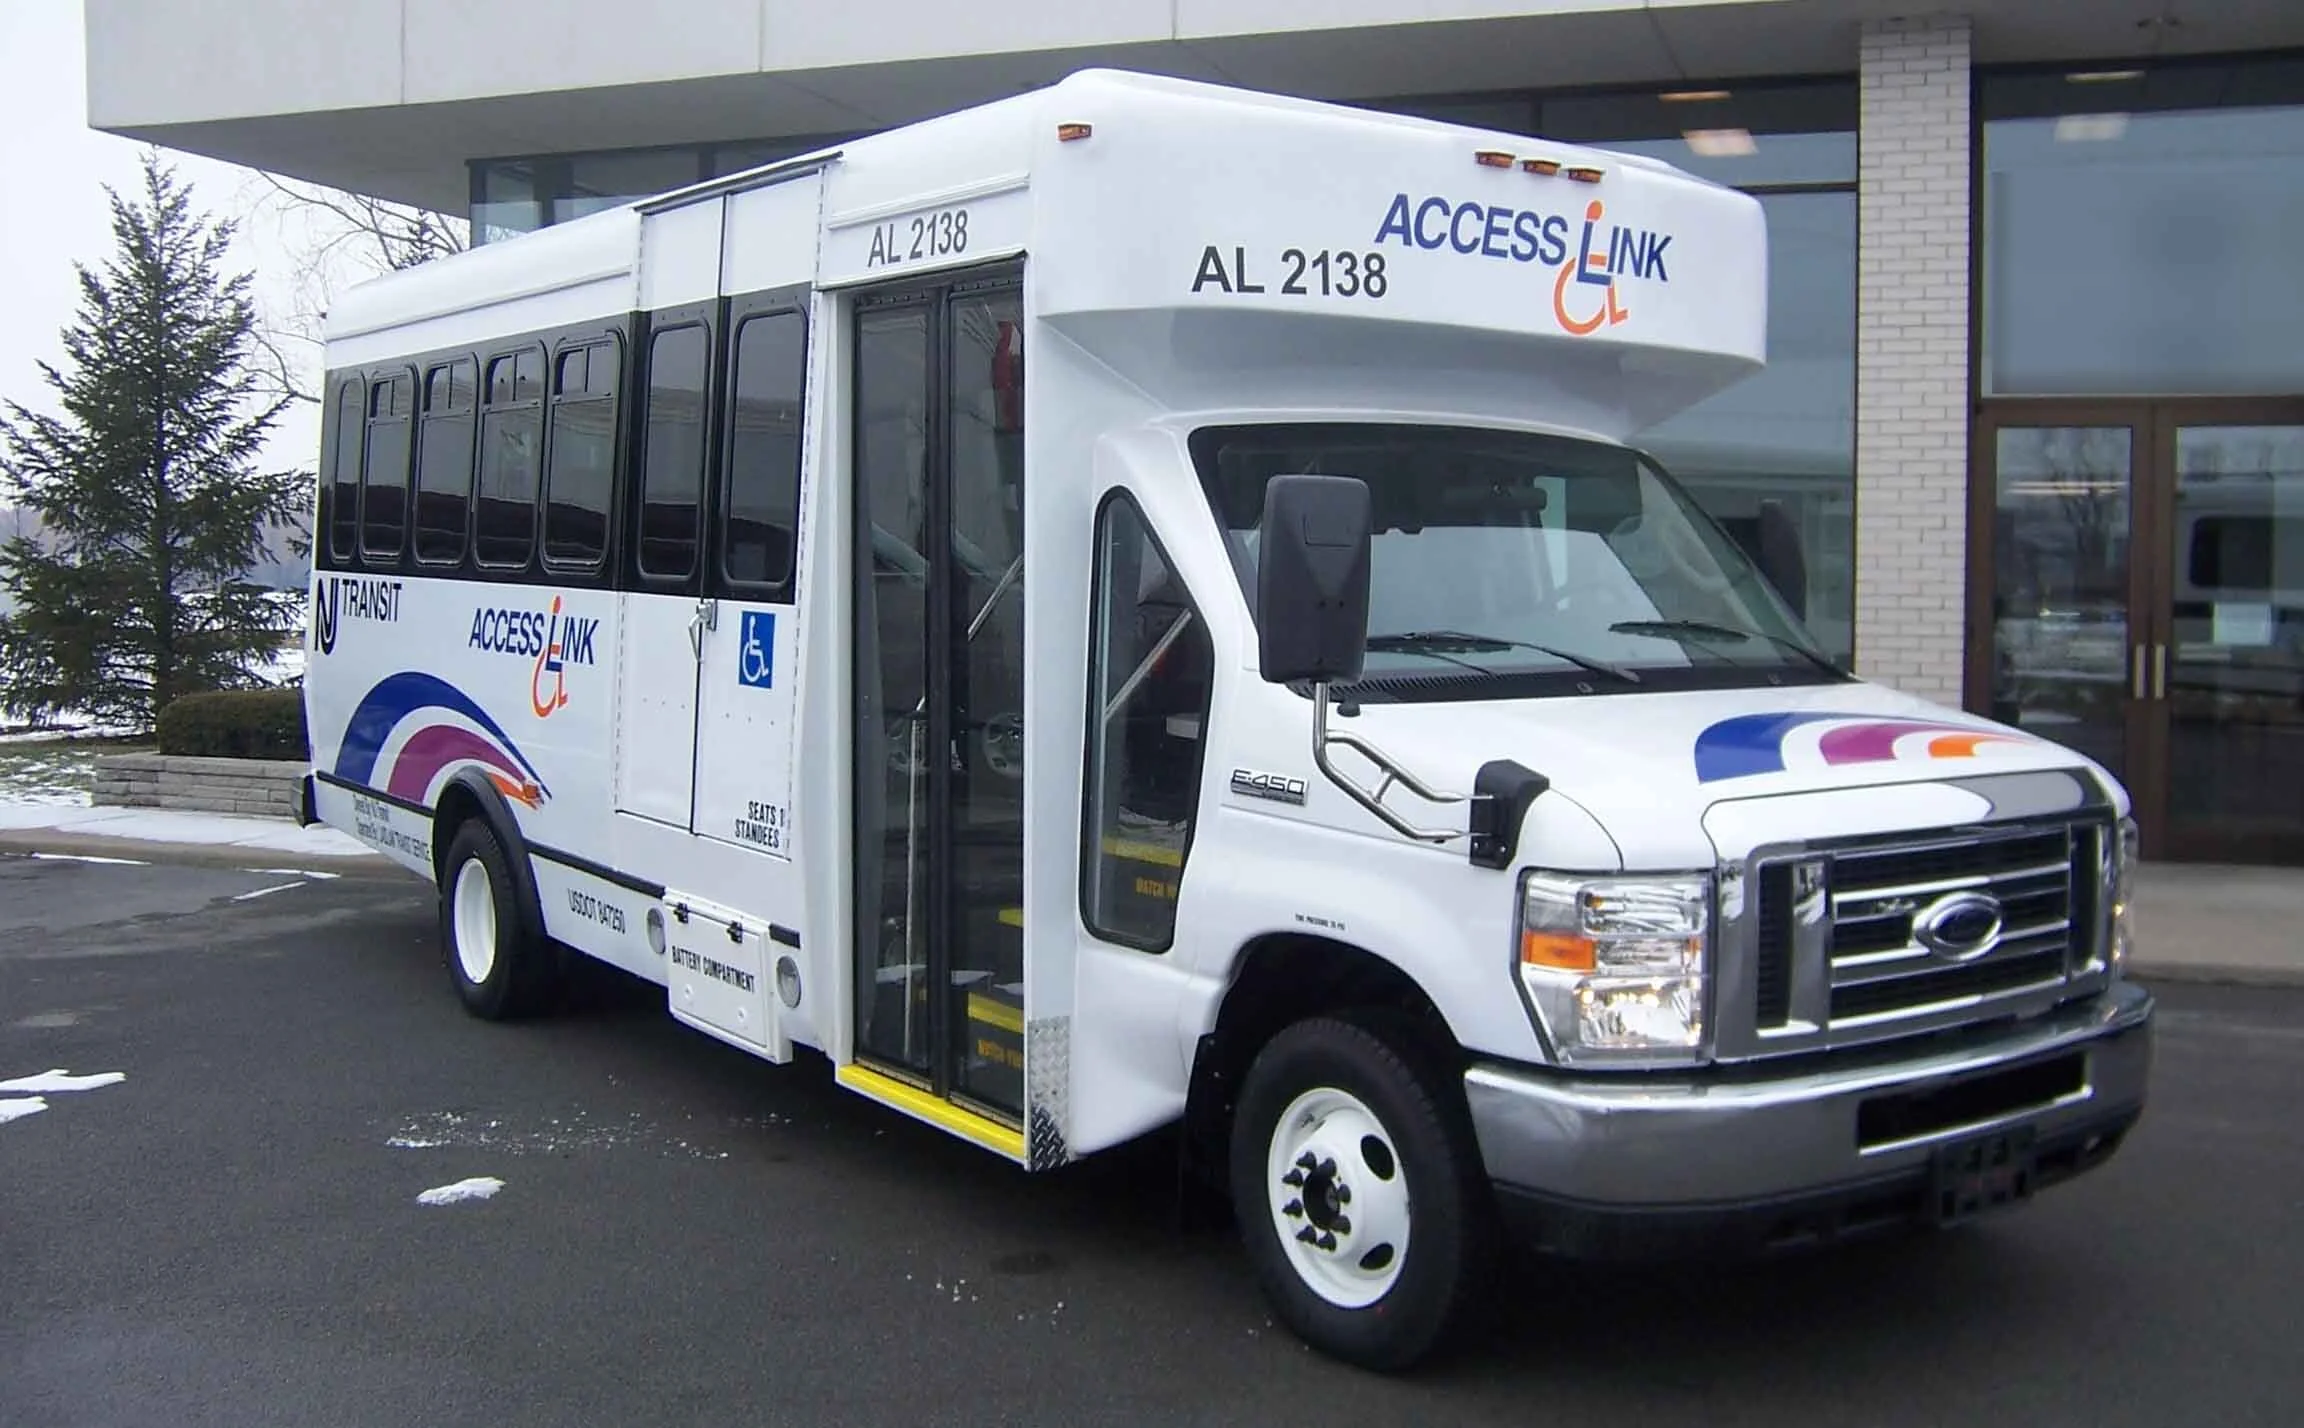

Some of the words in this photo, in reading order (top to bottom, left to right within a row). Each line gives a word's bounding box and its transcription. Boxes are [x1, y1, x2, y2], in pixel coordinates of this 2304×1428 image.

[868, 224, 901, 267] AL
[909, 209, 968, 260] 2138
[1375, 193, 1568, 266] ACCESS
[1576, 219, 1673, 287] LINK
[1191, 245, 1264, 294] AL
[1280, 249, 1387, 299] 2138
[315, 578, 339, 655] NJ
[343, 578, 403, 622] TRANSIT
[469, 607, 544, 658] ACCESS
[545, 615, 600, 672] LINK
[735, 818, 780, 849] STANDEES
[748, 801, 776, 826] SEATS
[567, 888, 597, 921] USDOT
[672, 945, 701, 976] BATTERY
[703, 957, 755, 994] COMPARTMENT
